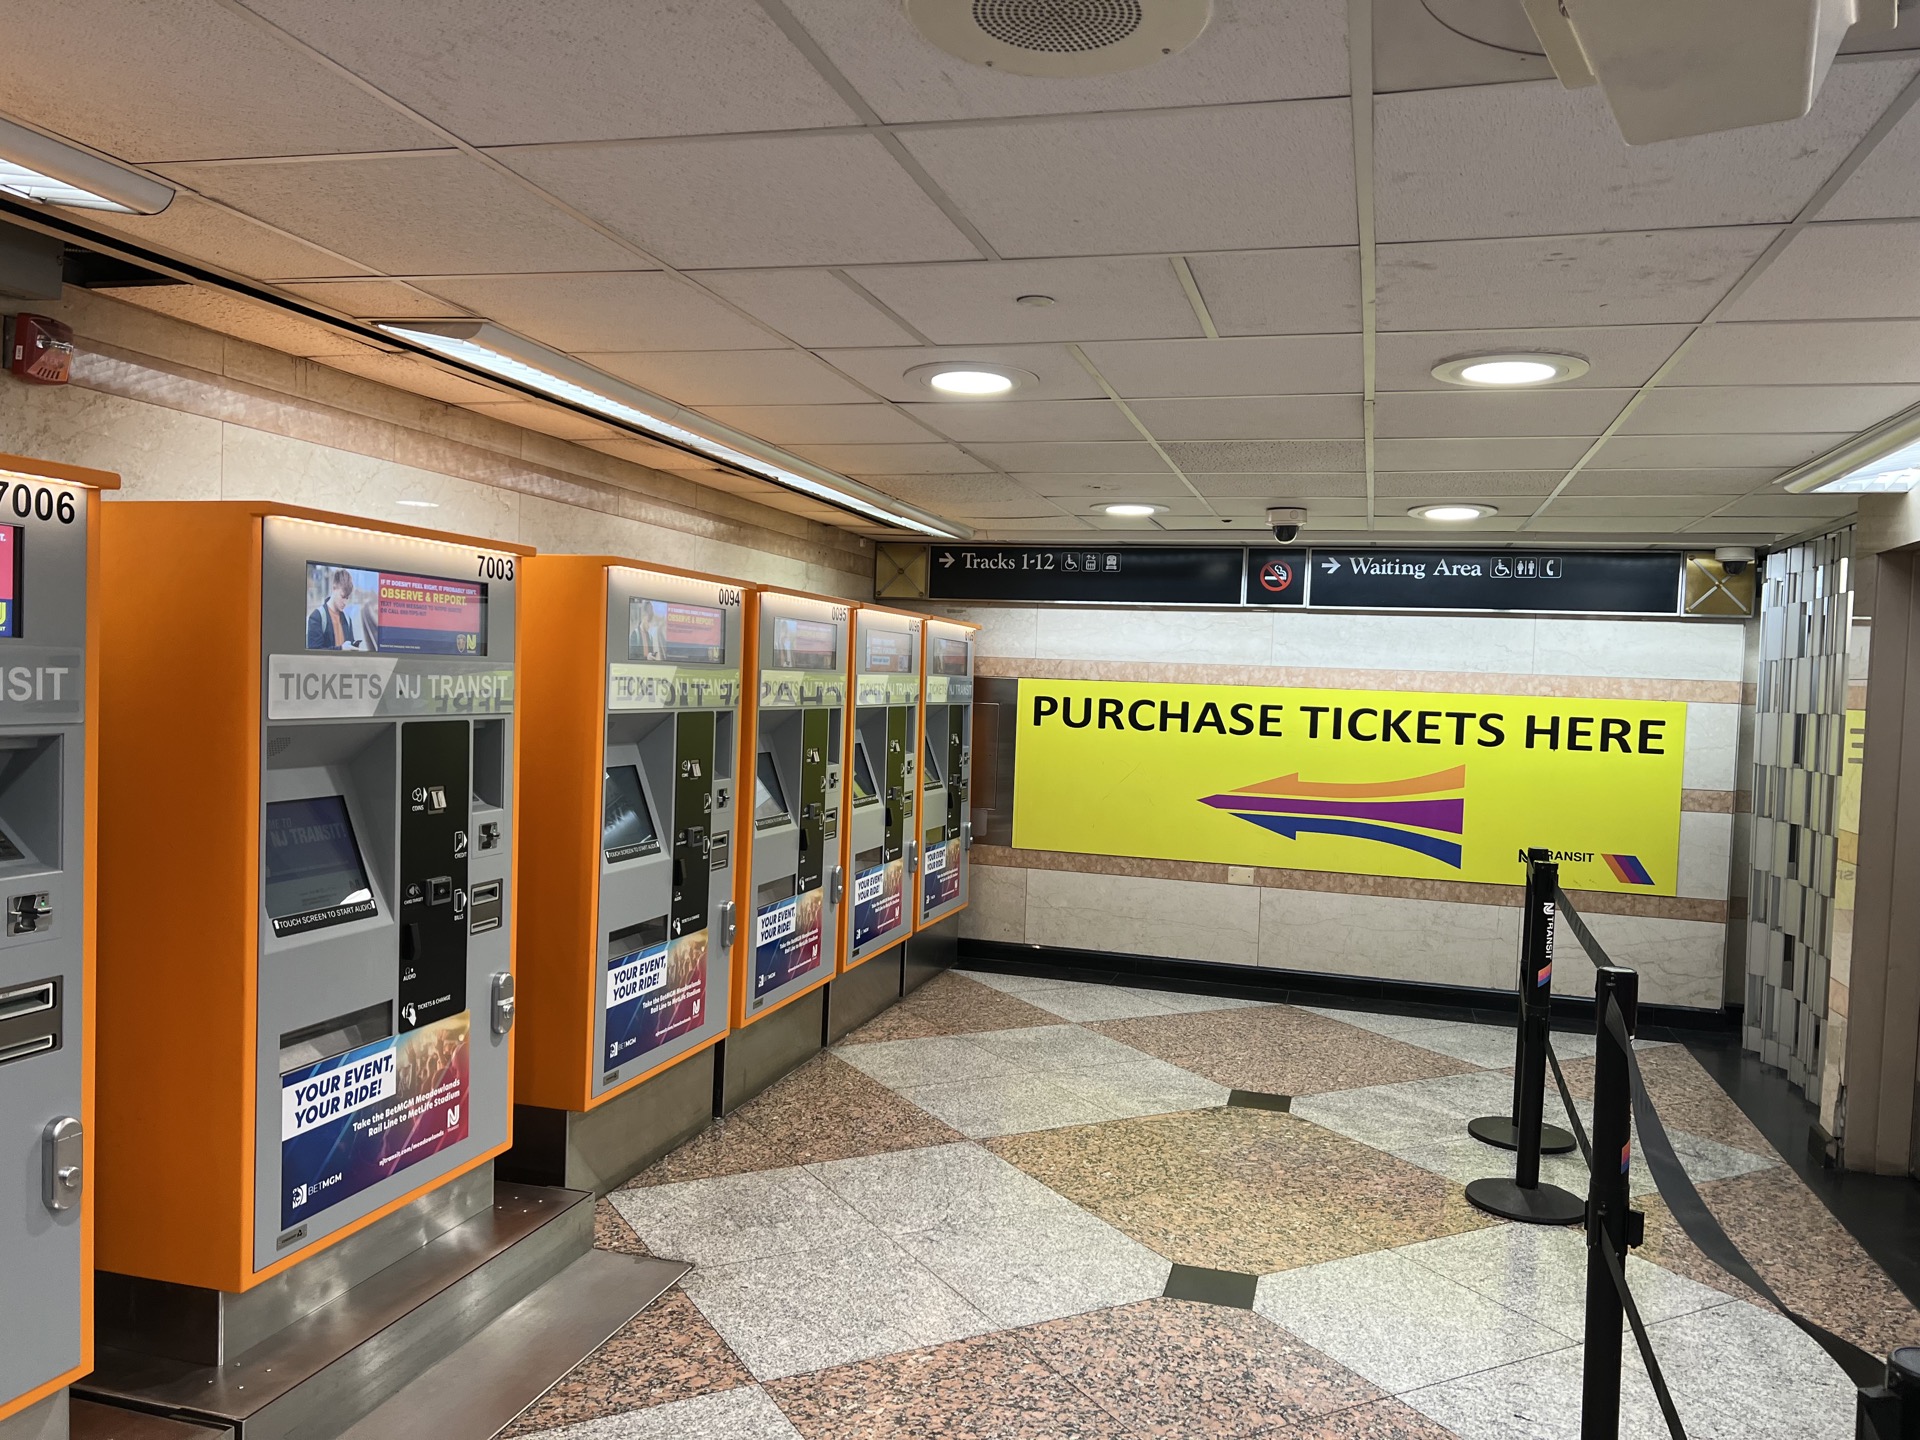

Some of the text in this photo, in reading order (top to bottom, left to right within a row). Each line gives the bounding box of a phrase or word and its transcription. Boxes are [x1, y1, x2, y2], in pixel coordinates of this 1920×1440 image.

[477, 555, 514, 581] 7003
[962, 553, 1054, 570] Tracks 1-12
[1350, 557, 1482, 580] Waiting Area
[380, 588, 467, 606] OBSERVE & REPORT.
[718, 588, 740, 606] 0094
[832, 606, 846, 622] 0095
[0, 666, 69, 701] SIT
[279, 673, 508, 700] TICKETS NJ TRANSIT
[614, 676, 736, 696] TICKETS NJ TRANSIT
[1033, 696, 1666, 754] PURCHASE TICKETS HERE
[412, 804, 424, 812] COINS
[288, 822, 348, 844] TRANSIT!
[858, 878, 870, 890] YOUR
[858, 890, 870, 902] YOUR
[279, 902, 372, 929] TOUCH SCREEN TO START AUDIO
[761, 914, 776, 929] YOUR
[760, 926, 776, 942] YOUR
[777, 920, 792, 934] RIDE!
[1545, 918, 1554, 959] TRANSIT
[402, 973, 416, 982] AUDIO
[614, 956, 666, 986] YOUR EVENT,
[613, 972, 660, 1002] YOUR RIDE!
[418, 1002, 432, 1010] TICKETS
[436, 994, 451, 1004] CHANGE
[295, 1054, 394, 1107] YOUR EVENT,
[295, 1078, 382, 1129] YOUR RIDE!
[352, 1078, 460, 1132] Take the BetMGM Meadowlands
[368, 1090, 460, 1138] Rail Line to MetLife Stadium
[379, 1130, 444, 1166] njtransit.com/meadowlands
[308, 1172, 342, 1196] BETMGM
